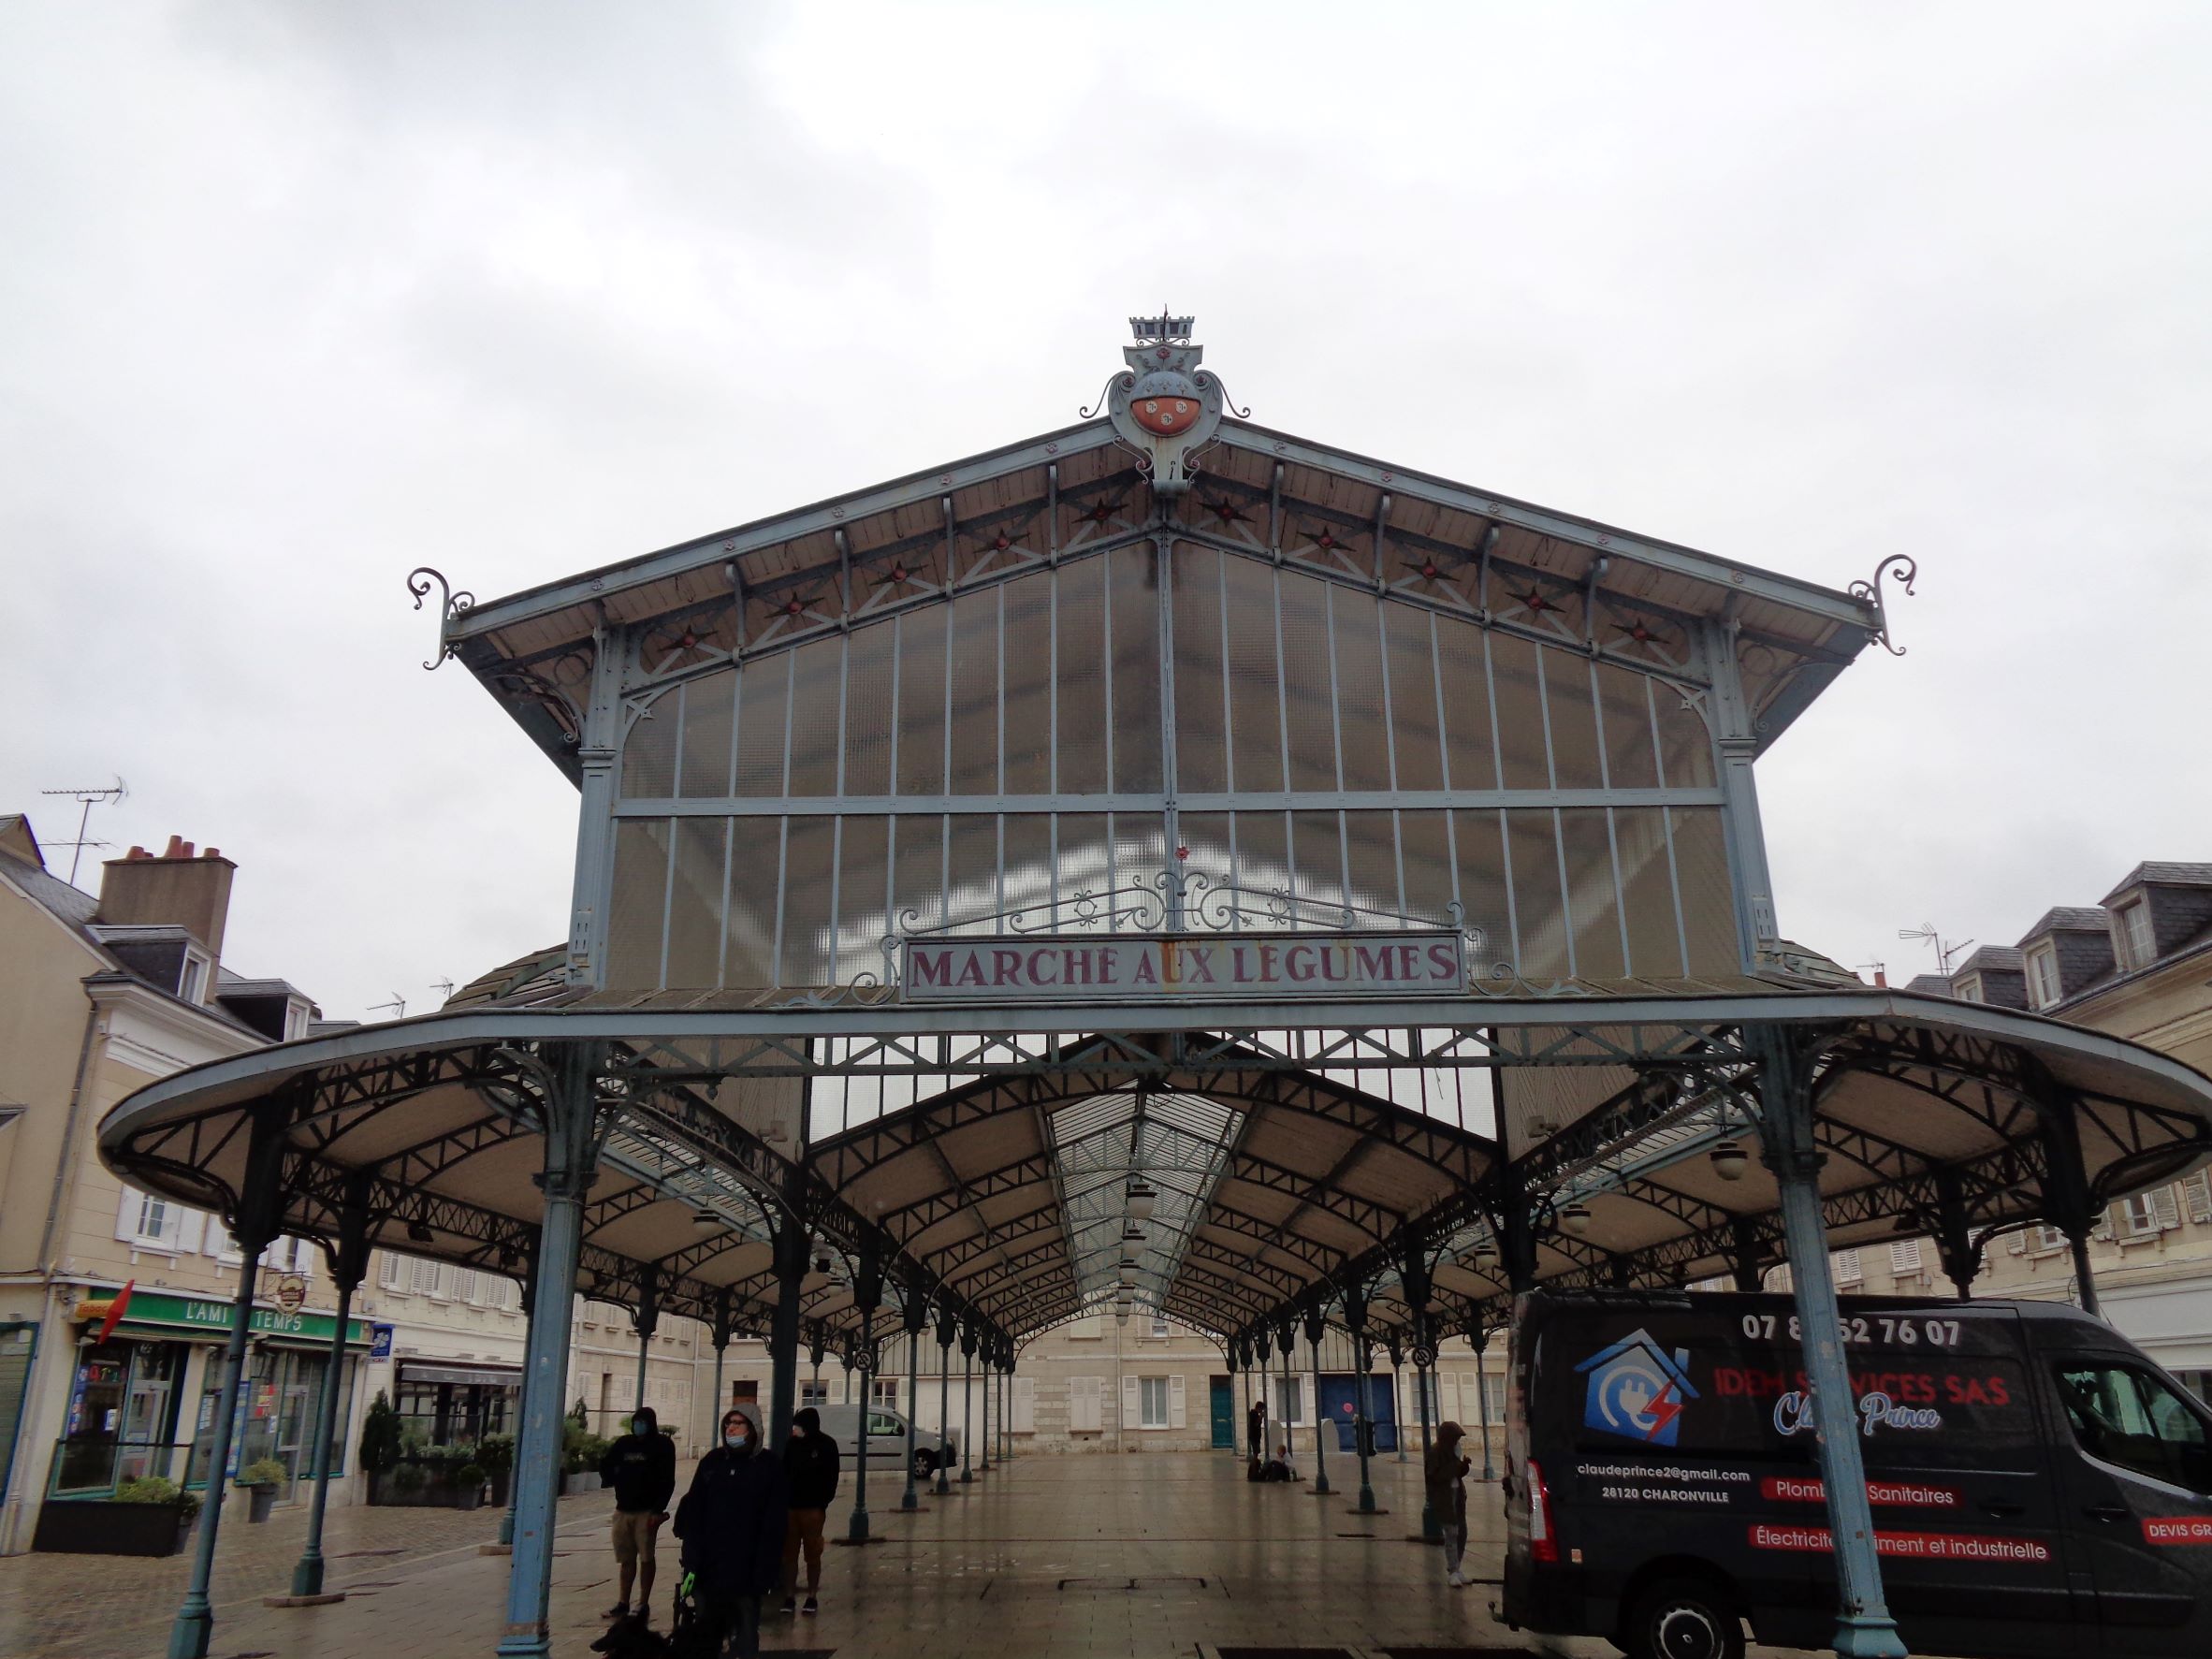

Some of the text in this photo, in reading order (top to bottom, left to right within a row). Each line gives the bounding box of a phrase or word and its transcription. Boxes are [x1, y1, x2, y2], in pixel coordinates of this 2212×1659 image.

[1132, 947, 1216, 984] AUX
[186, 1302, 302, 1331] L'AMI TEMPS
[1742, 1315, 1776, 1340] 07
[1838, 1317, 1870, 1343] 52
[1879, 1318, 1917, 1345] 76
[1926, 1320, 1960, 1346] 07
[1945, 1375, 2011, 1405] SAS
[1859, 1391, 1942, 1436] Prince
[1577, 1463, 1751, 1482] claudeprince2@gmail.com
[1602, 1487, 1729, 1503] 28120 CHARONVILLE
[1869, 1485, 1954, 1505] Sanitaires
[2148, 1524, 2189, 1537] DEVIS
[1929, 1539, 1946, 1554] et
[1951, 1539, 2046, 1560] industrielle
